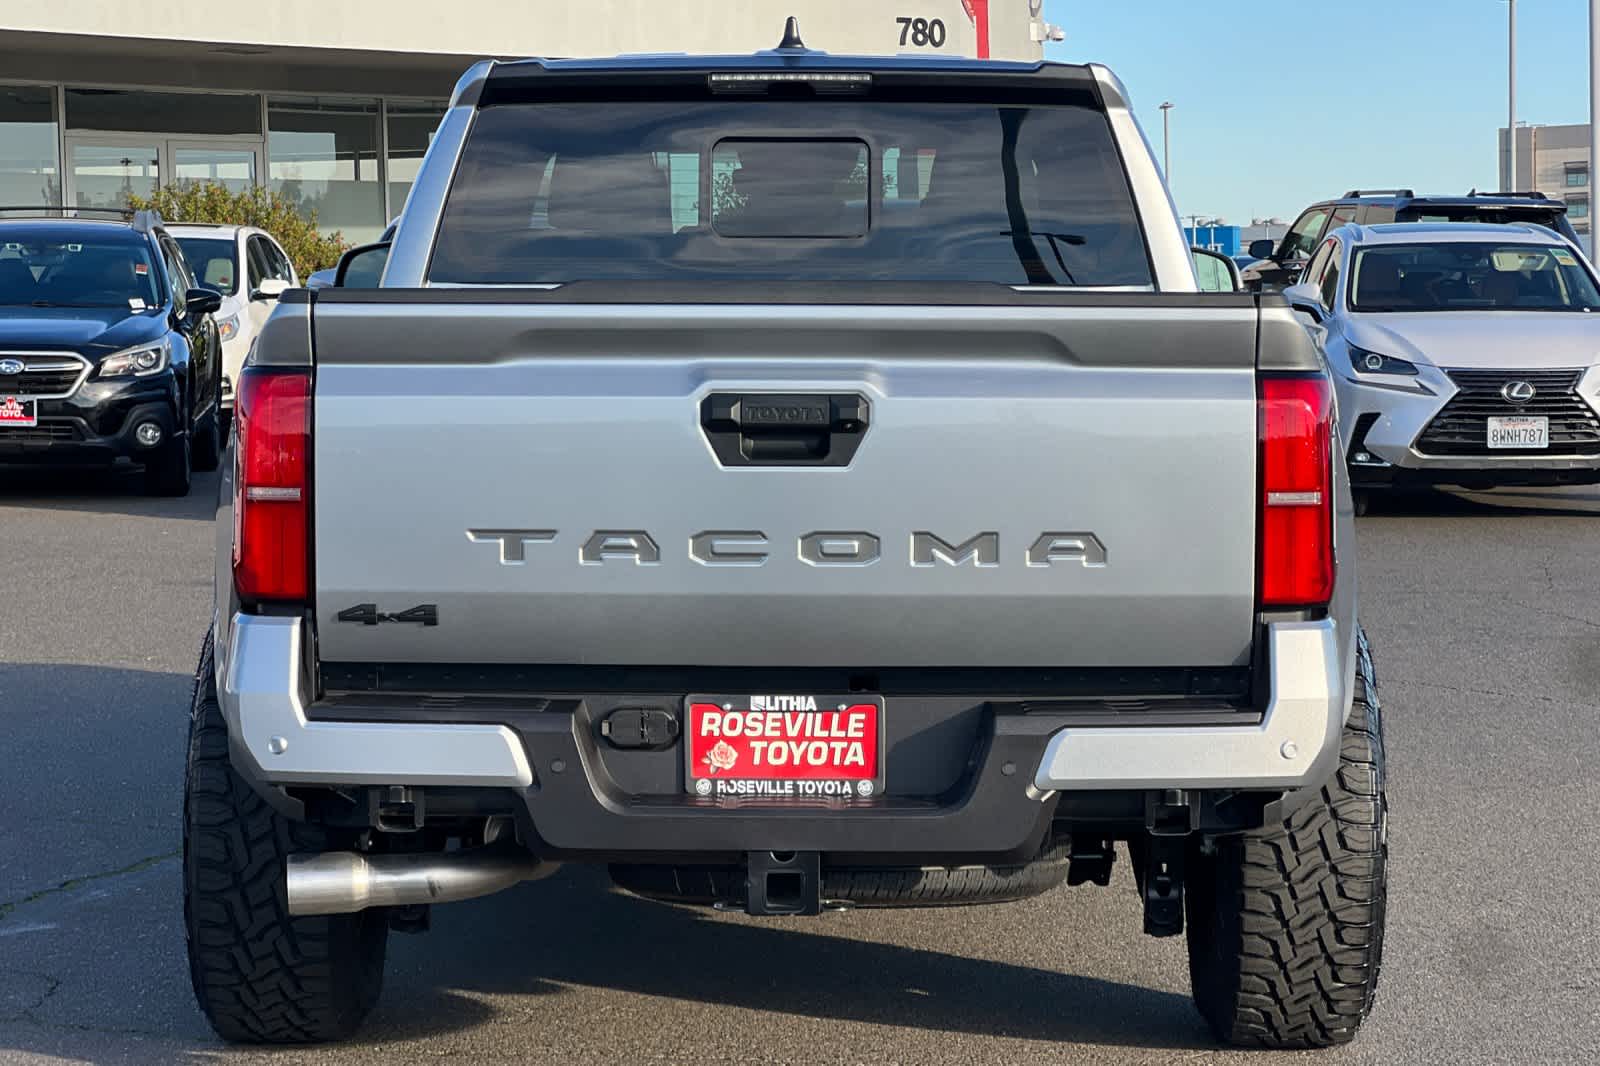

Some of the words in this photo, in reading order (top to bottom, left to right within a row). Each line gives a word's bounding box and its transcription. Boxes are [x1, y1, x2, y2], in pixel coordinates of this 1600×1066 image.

[896, 17, 946, 48] 780
[745, 407, 826, 421] TOYOTA
[1491, 429, 1544, 443] 8WNH787
[466, 528, 1108, 568] TACOMA
[765, 695, 818, 711] LITHIA
[701, 711, 866, 738] ROSEVILLE
[750, 740, 865, 766] TOYOTA
[717, 779, 794, 793] ROSEVILLE
[798, 780, 852, 794] TOYOTA
